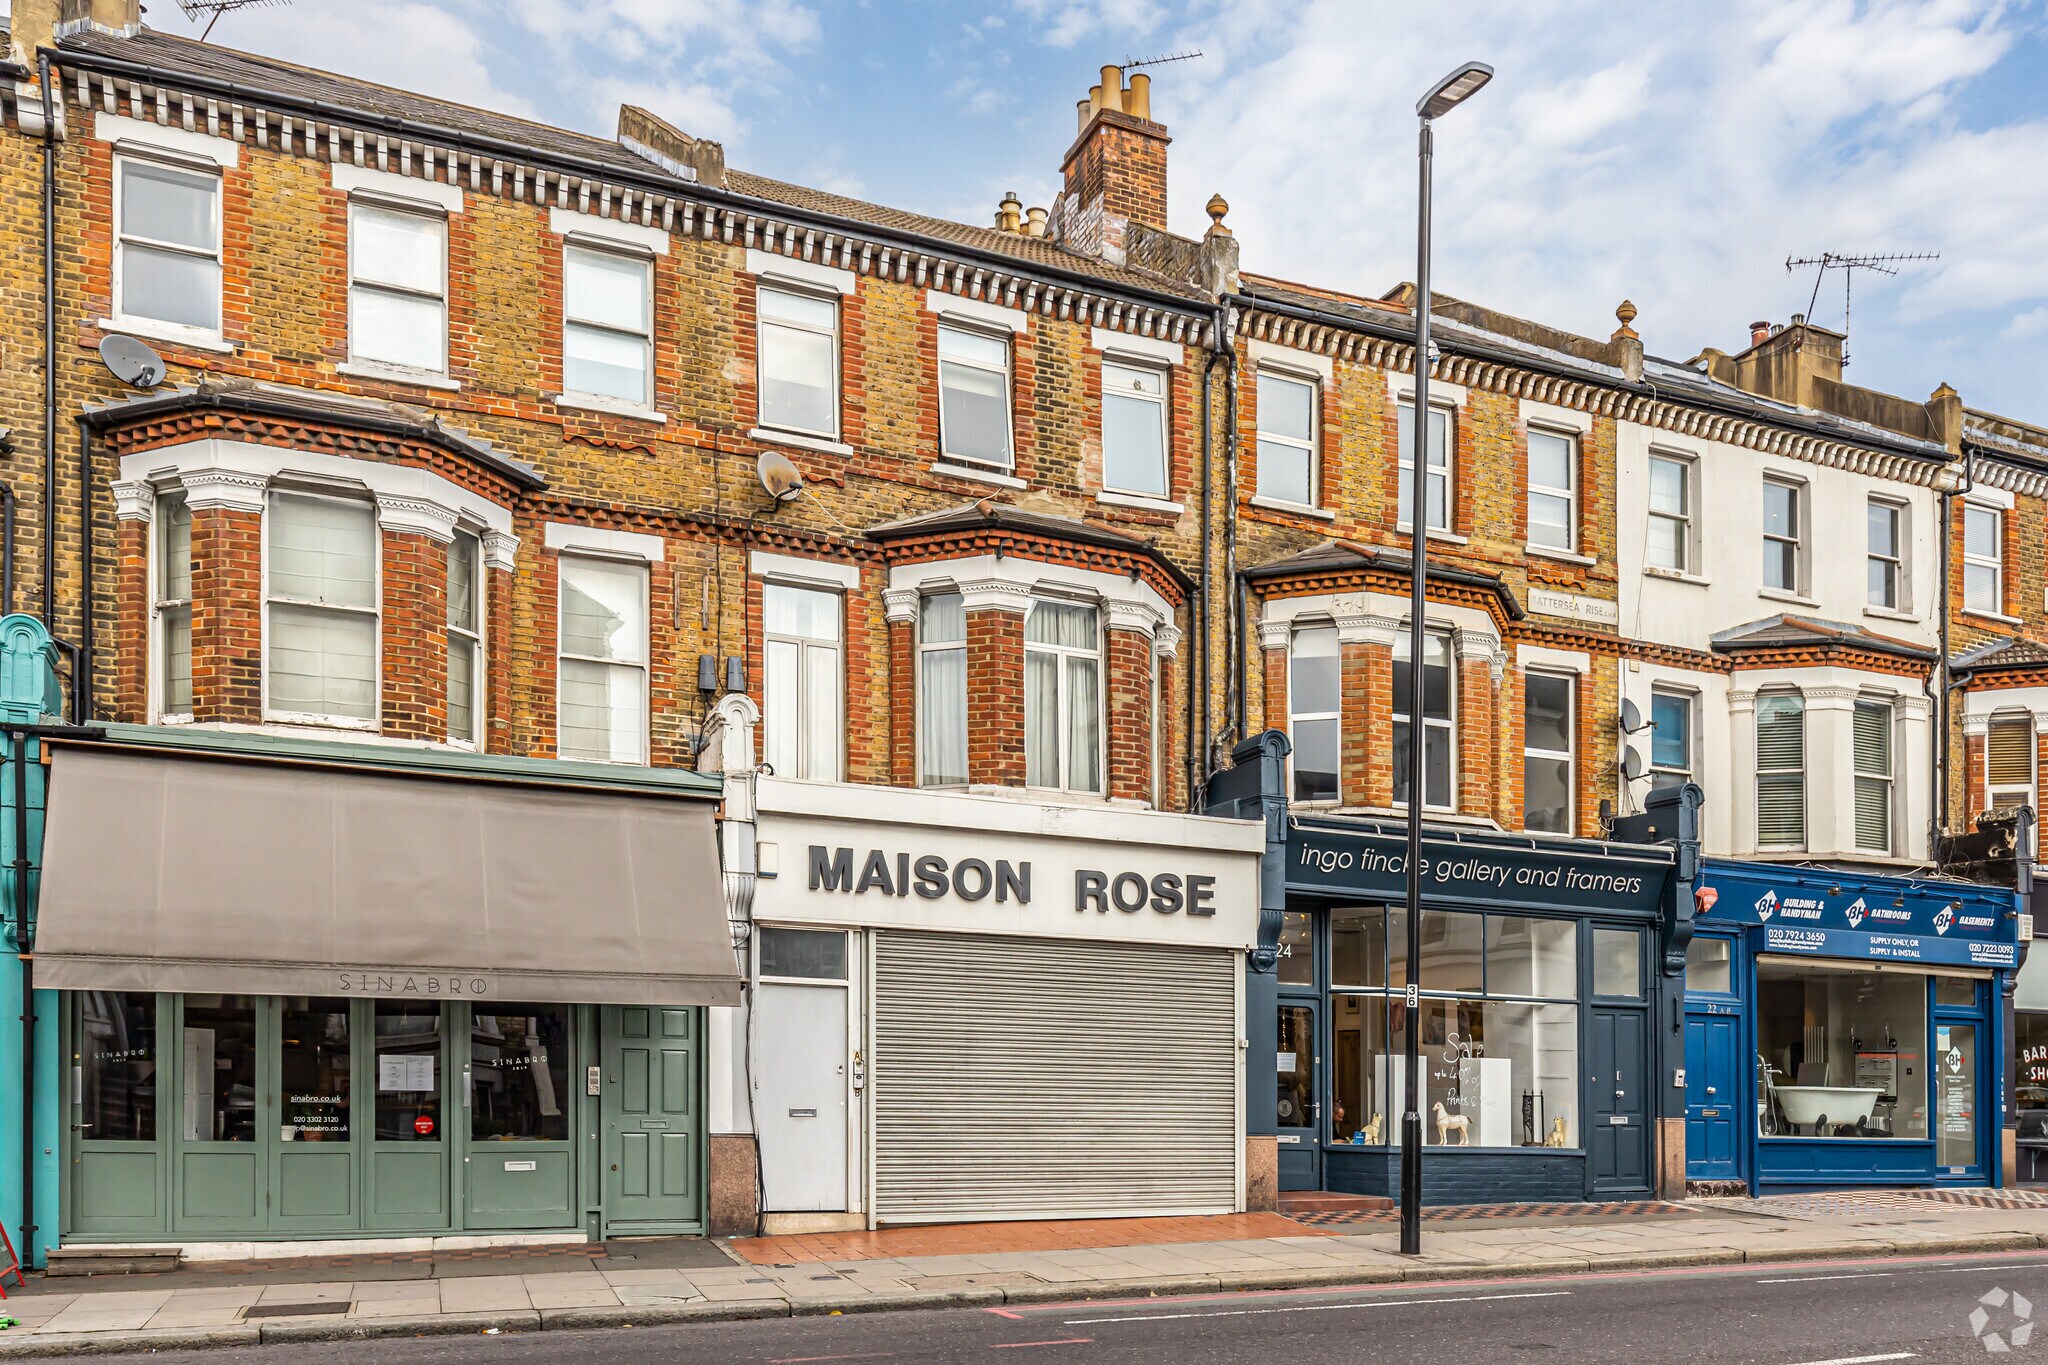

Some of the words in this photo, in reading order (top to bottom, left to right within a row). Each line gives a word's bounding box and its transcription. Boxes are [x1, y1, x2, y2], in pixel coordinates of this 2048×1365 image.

[1532, 596, 1580, 612] BATTERSEA
[1586, 604, 1603, 616] RISE
[1300, 843, 1353, 873] ingo
[1434, 858, 1511, 887] gallery
[1515, 866, 1561, 887] and
[1565, 867, 1642, 894] framers
[808, 845, 1032, 904] MAISON
[1075, 869, 1216, 917] ROSE
[1783, 898, 1816, 909] BUILDING
[1818, 900, 1824, 910] &
[1780, 908, 1822, 920] HANDYMAN
[1871, 908, 1912, 921] BATHROOMS
[1959, 915, 1995, 927] BASEMENTS
[1768, 929, 1784, 938] 020
[1785, 930, 1804, 940] 7924
[1806, 931, 1826, 942] 3650
[1870, 936, 1891, 945] SUPPLY
[1909, 939, 1919, 947] OR
[1276, 943, 1292, 958] 24
[1869, 947, 1891, 956] SUPPLY
[1892, 948, 1898, 956] &
[1898, 949, 1921, 958] INSTALL
[1969, 943, 1981, 952] 020
[1982, 944, 1997, 953] 7223
[1998, 945, 2014, 954] 0093
[340, 973, 487, 994] SINABRO
[1707, 1004, 1717, 1014] 22
[1443, 1032, 1484, 1063] Sale
[94, 1049, 145, 1059] SINABRO
[2023, 1045, 2047, 1063] BAR
[492, 1055, 548, 1067] SINABRO
[2030, 1066, 2048, 1080] SH
[290, 1094, 341, 1102] sinabro.co.uk
